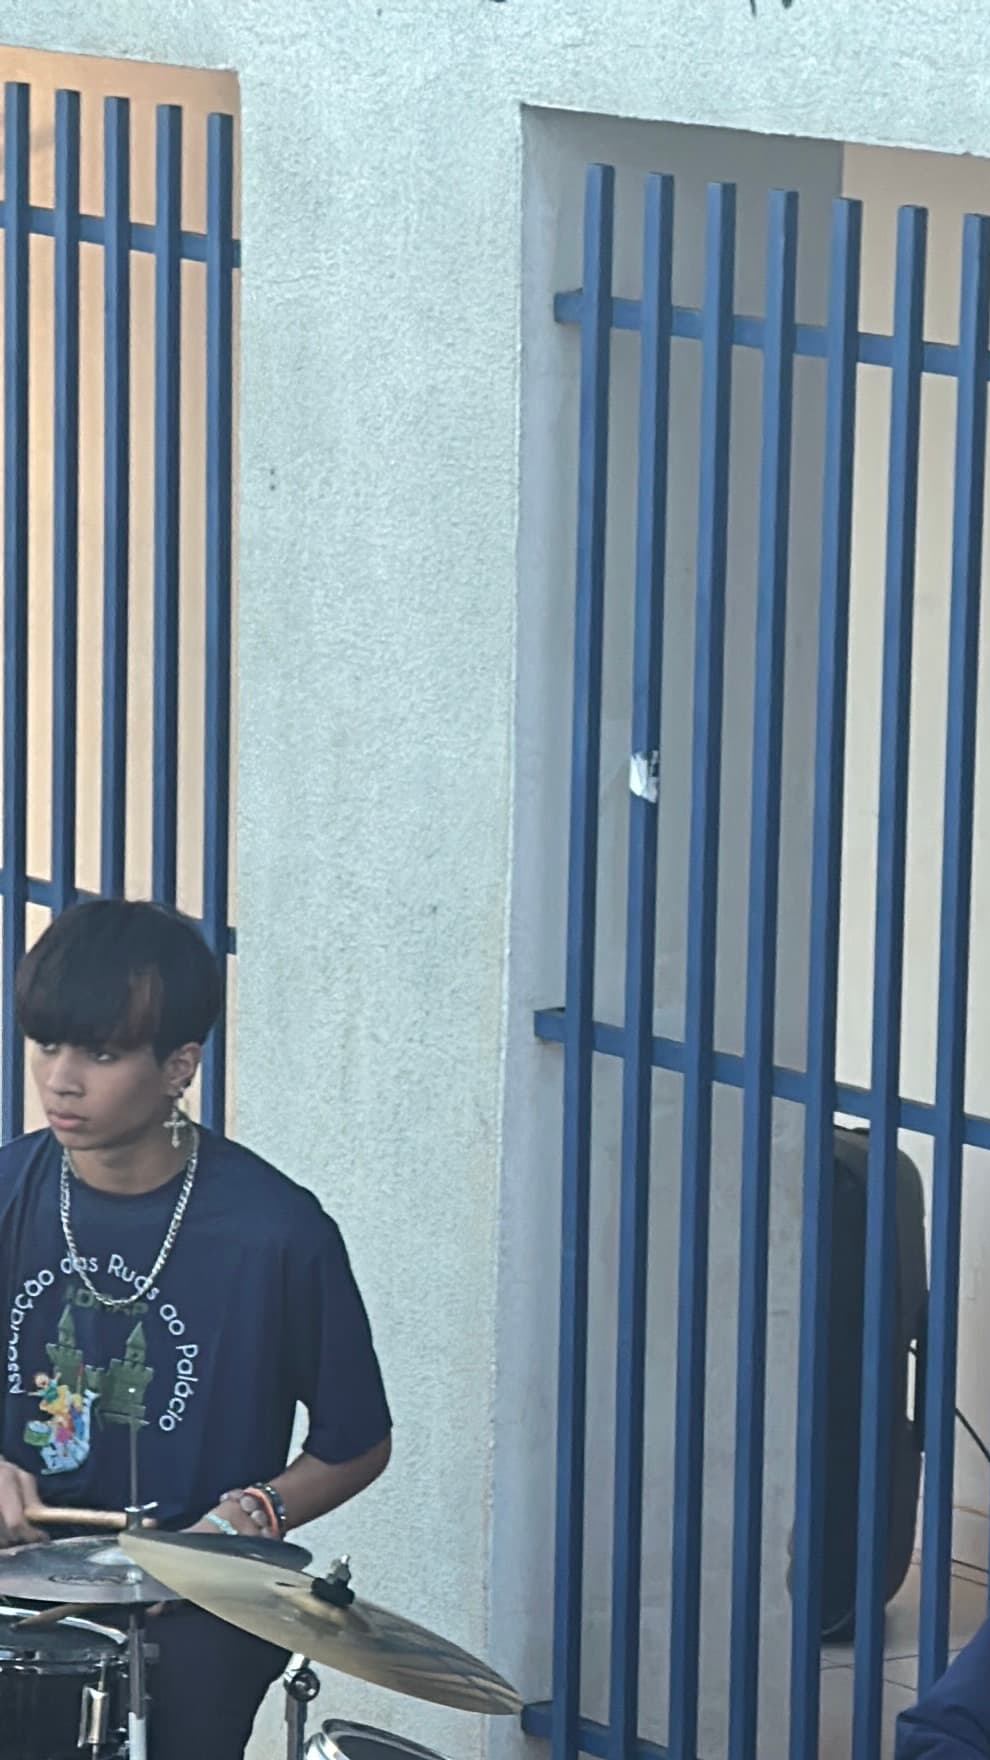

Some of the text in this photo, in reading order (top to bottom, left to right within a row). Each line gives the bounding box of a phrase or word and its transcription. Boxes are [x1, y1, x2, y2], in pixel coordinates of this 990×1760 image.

[60, 1252, 99, 1274] das
[107, 1254, 160, 1301] Ruas
[159, 1304, 185, 1336] ao
[159, 1344, 199, 1431] Palácio
